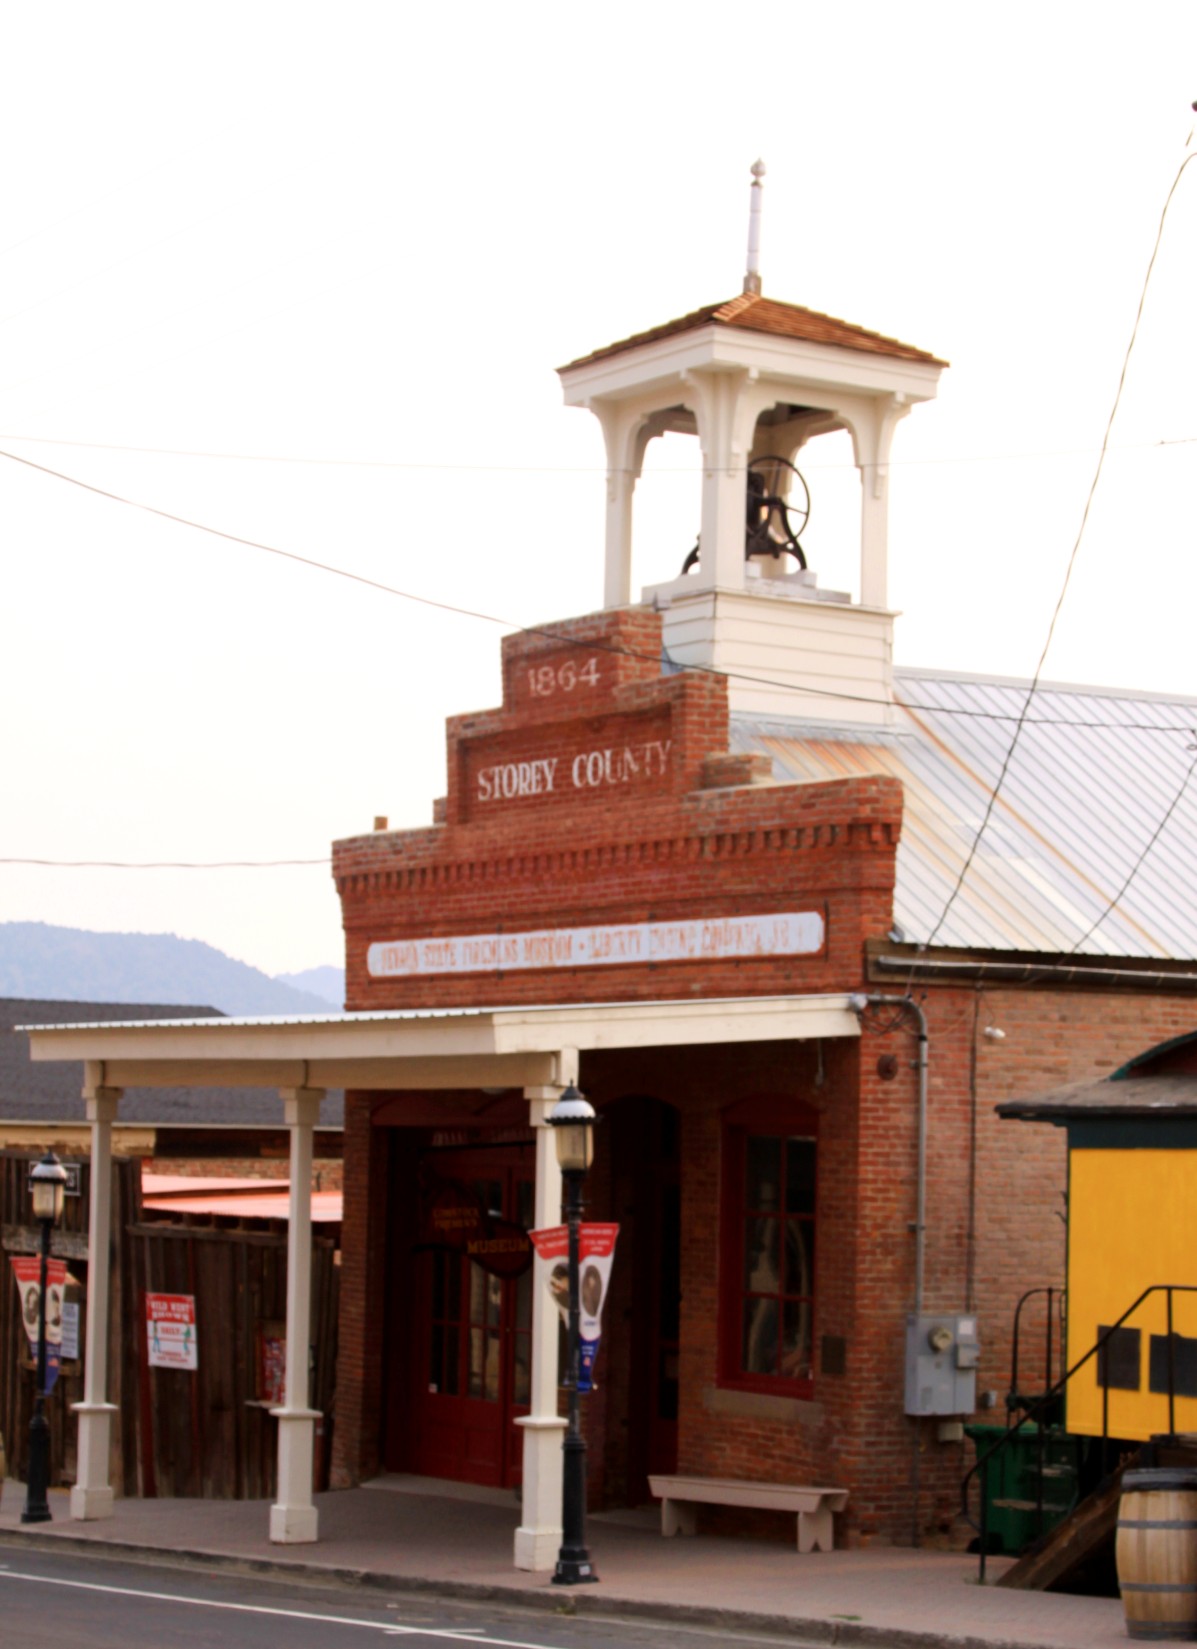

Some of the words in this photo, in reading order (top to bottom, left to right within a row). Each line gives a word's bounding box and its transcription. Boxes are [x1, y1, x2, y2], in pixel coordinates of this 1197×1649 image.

[527, 657, 602, 698] 1864
[477, 757, 558, 802] STOREY
[571, 739, 673, 789] COUNTY
[466, 1238, 530, 1254] MUSEUM
